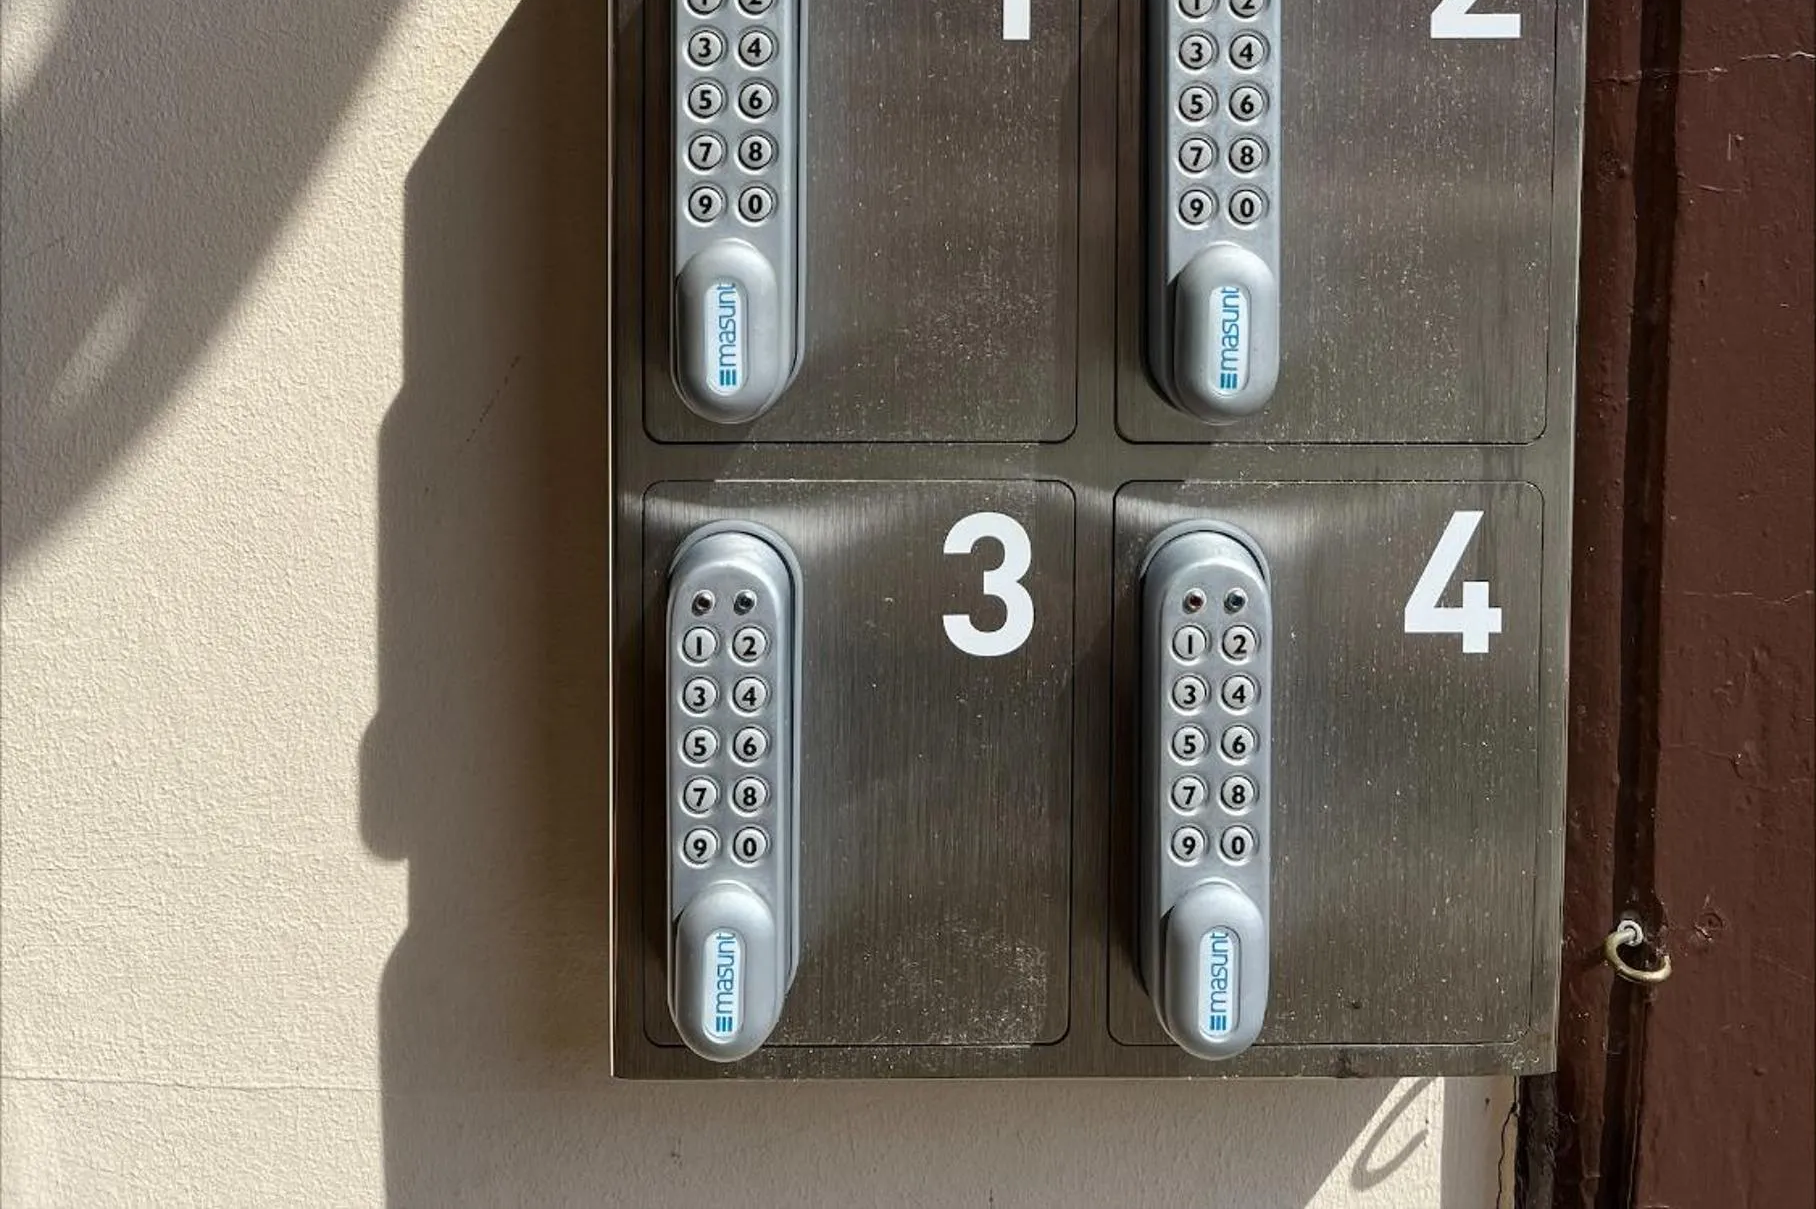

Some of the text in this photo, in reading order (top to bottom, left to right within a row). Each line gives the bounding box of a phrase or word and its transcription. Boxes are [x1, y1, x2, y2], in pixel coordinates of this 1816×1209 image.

[698, 37, 762, 58] 3 4
[1189, 42, 1254, 63] 3 4
[698, 89, 763, 110] 5 6
[1189, 94, 1255, 115] 5 6
[698, 141, 763, 163] 7 8
[1190, 145, 1254, 167] 7 8
[698, 194, 763, 215] 9 0
[1189, 197, 1255, 219] 9 0
[716, 282, 737, 367] masunt
[1219, 287, 1240, 371] masunt
[942, 512, 1035, 657] 3
[1404, 510, 1502, 654] 4
[742, 636, 757, 657] 2
[1232, 634, 1247, 655] 2
[692, 686, 757, 707] 3 4
[1183, 684, 1246, 705] 3 4
[692, 736, 757, 757] 5 6
[1183, 734, 1246, 755] 5 6
[692, 786, 757, 807] 7 8
[1182, 784, 1246, 806] 7 8
[693, 837, 757, 858] 9 0
[1182, 835, 1246, 856] 9 0
[714, 932, 736, 1014] masunt
[1209, 932, 1230, 1013] masunt
